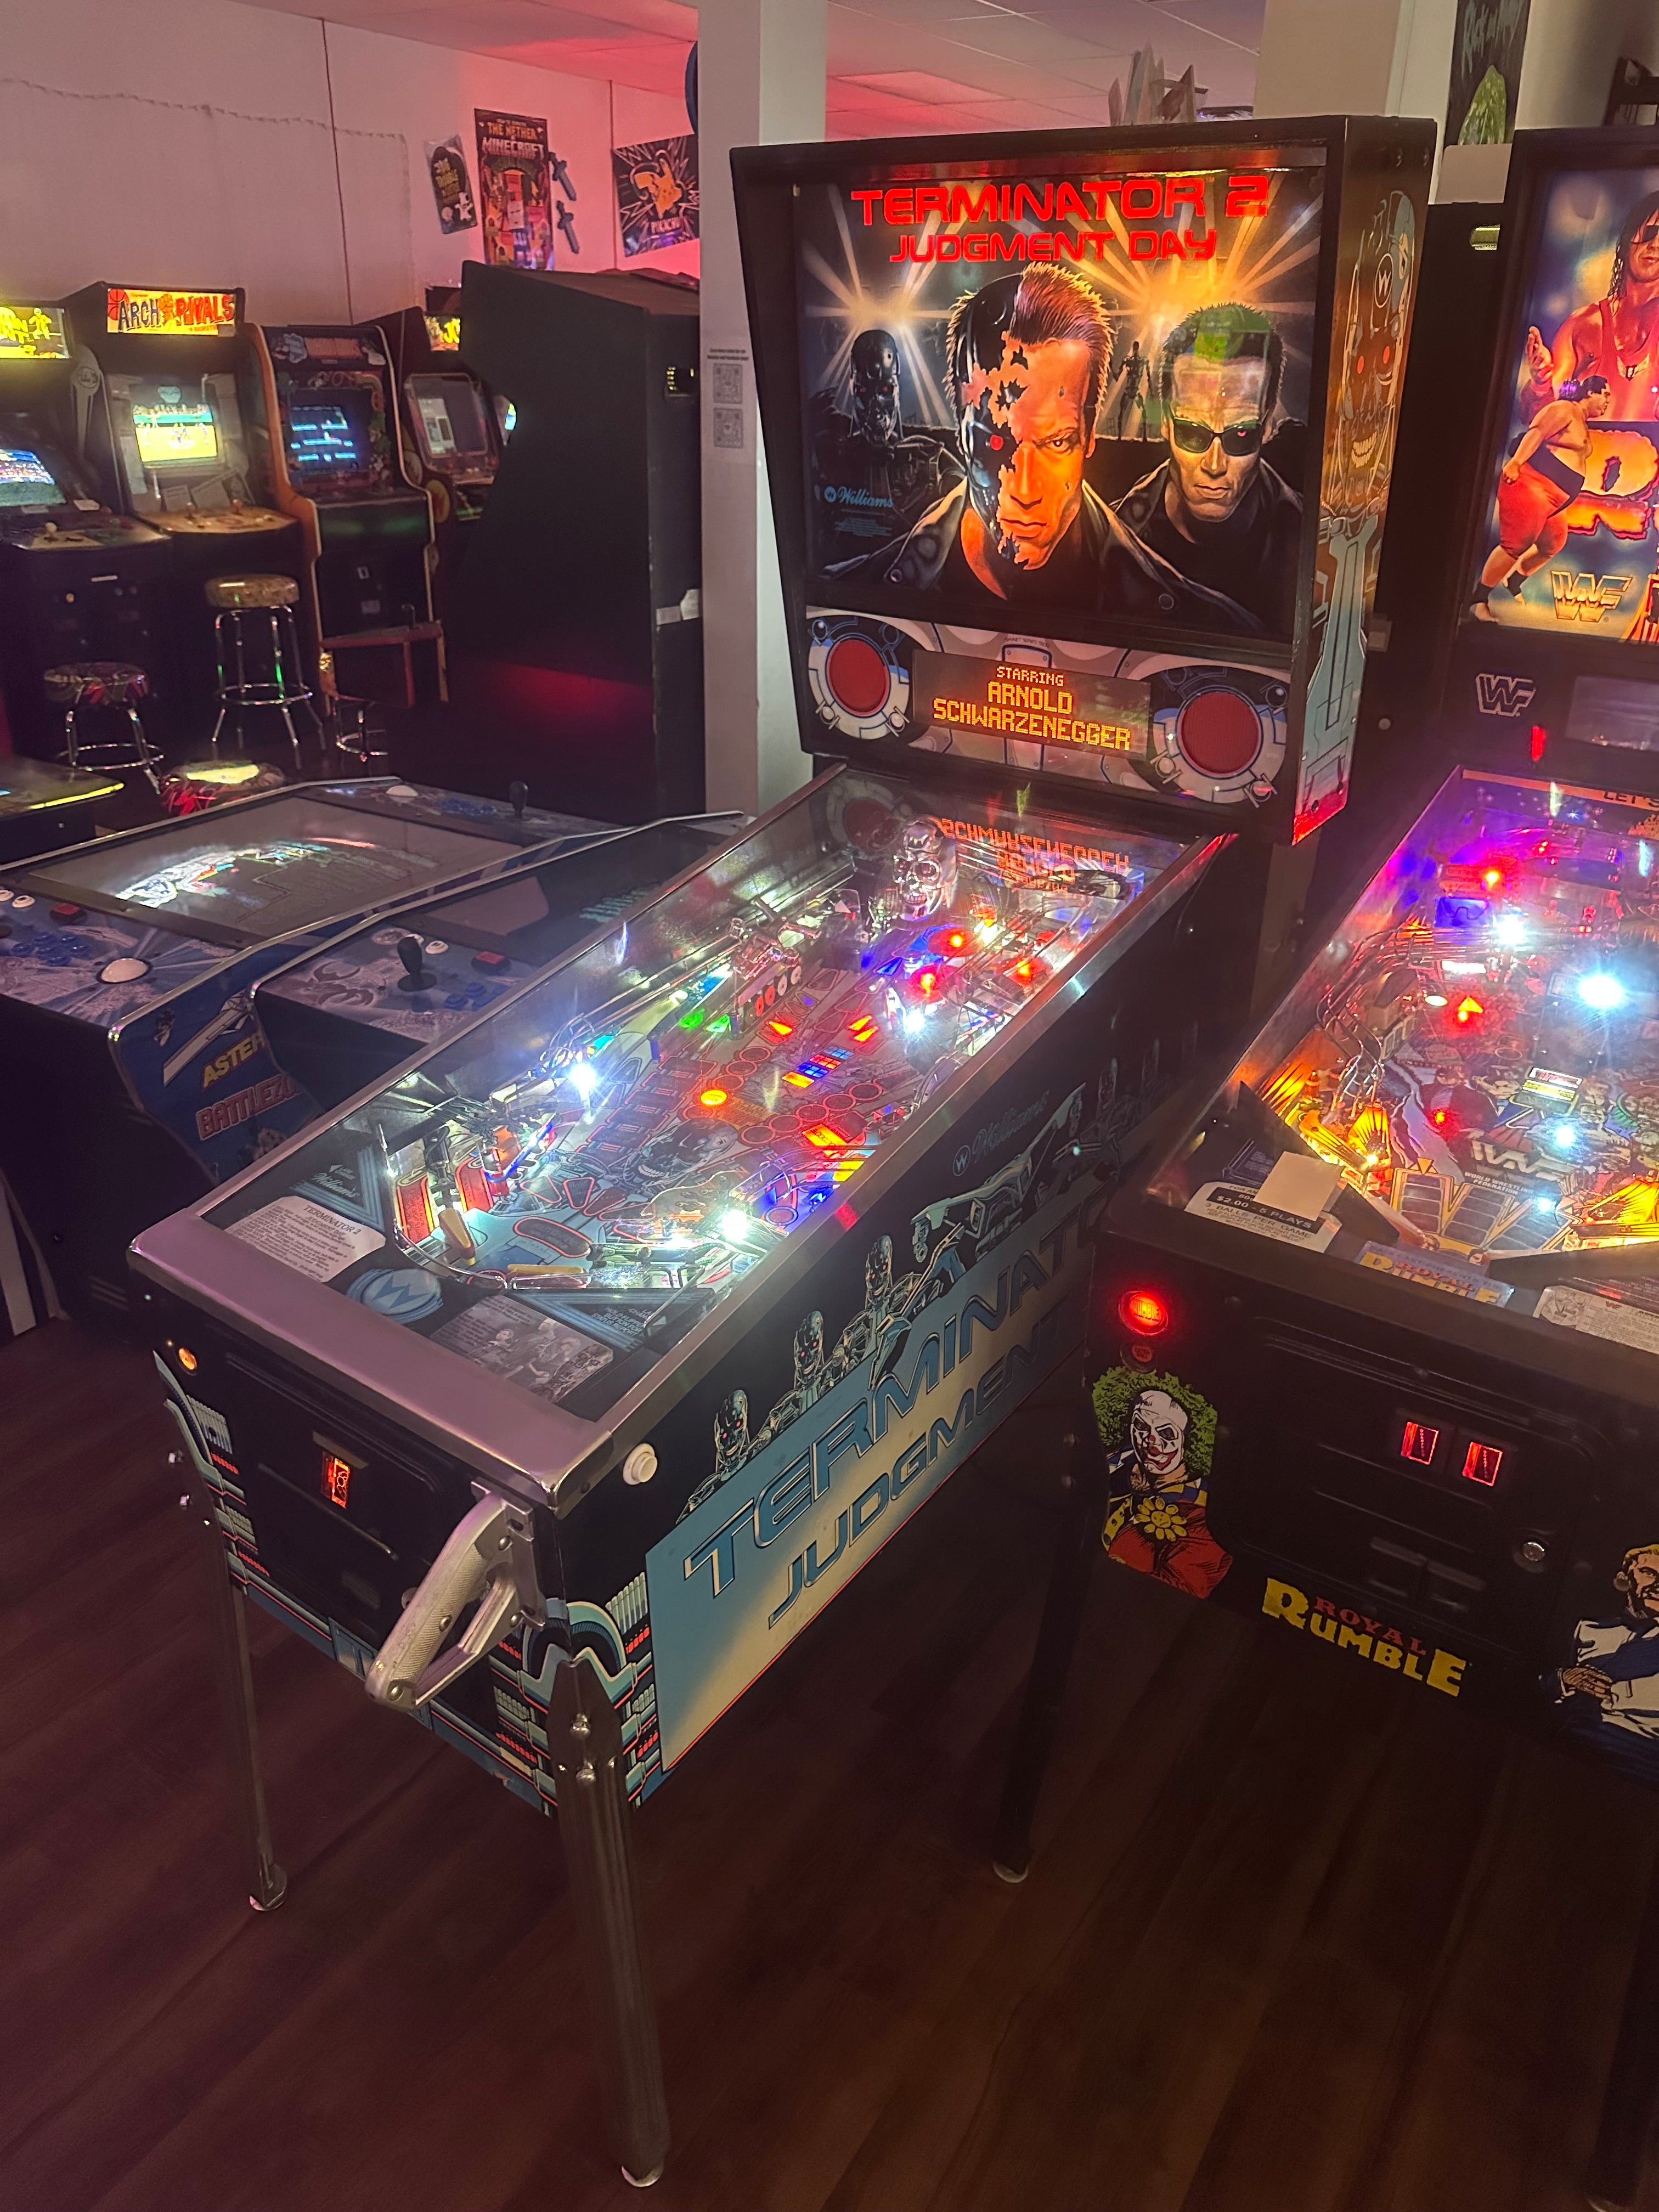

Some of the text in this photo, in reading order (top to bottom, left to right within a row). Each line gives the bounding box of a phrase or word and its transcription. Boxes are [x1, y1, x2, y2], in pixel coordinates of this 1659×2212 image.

[487, 122, 504, 136] THE
[505, 124, 537, 140] NETHER
[482, 137, 544, 160] MINECRAFT
[851, 175, 1269, 226] TERMINATOR 2
[889, 228, 1218, 263] JUDGMENT DAY
[118, 294, 234, 332] ARCH RIVALS
[837, 486, 893, 507] Williams
[1550, 570, 1632, 623] WWF
[996, 665, 1064, 686] STARRING
[988, 681, 1073, 714] ARNOLD
[1476, 673, 1536, 716] WWF
[934, 698, 1131, 751] SCHWARZENEGGER
[1464, 1172, 1534, 1194] WORLD WRESTLING
[1473, 1180, 1518, 1195] FEDERATION
[304, 1205, 354, 1233] TERMINATOR
[1216, 1195, 1249, 1207] $2.00
[1269, 1211, 1312, 1228] PLAYS
[1216, 1205, 1250, 1219] BALLS
[1253, 1215, 1276, 1226] PER
[1280, 1224, 1312, 1239] GAME
[1397, 1262, 1474, 1291] ROYAL
[591, 1313, 639, 1336] STATUS REPORT
[604, 1313, 642, 1333] BUTTON FOR
[683, 1180, 1110, 1599] TERMINATO
[769, 1314, 1059, 1629] JUDGMENT
[1262, 1577, 1466, 1697] RUMBLE
[1313, 1596, 1426, 1656] ROYAL
